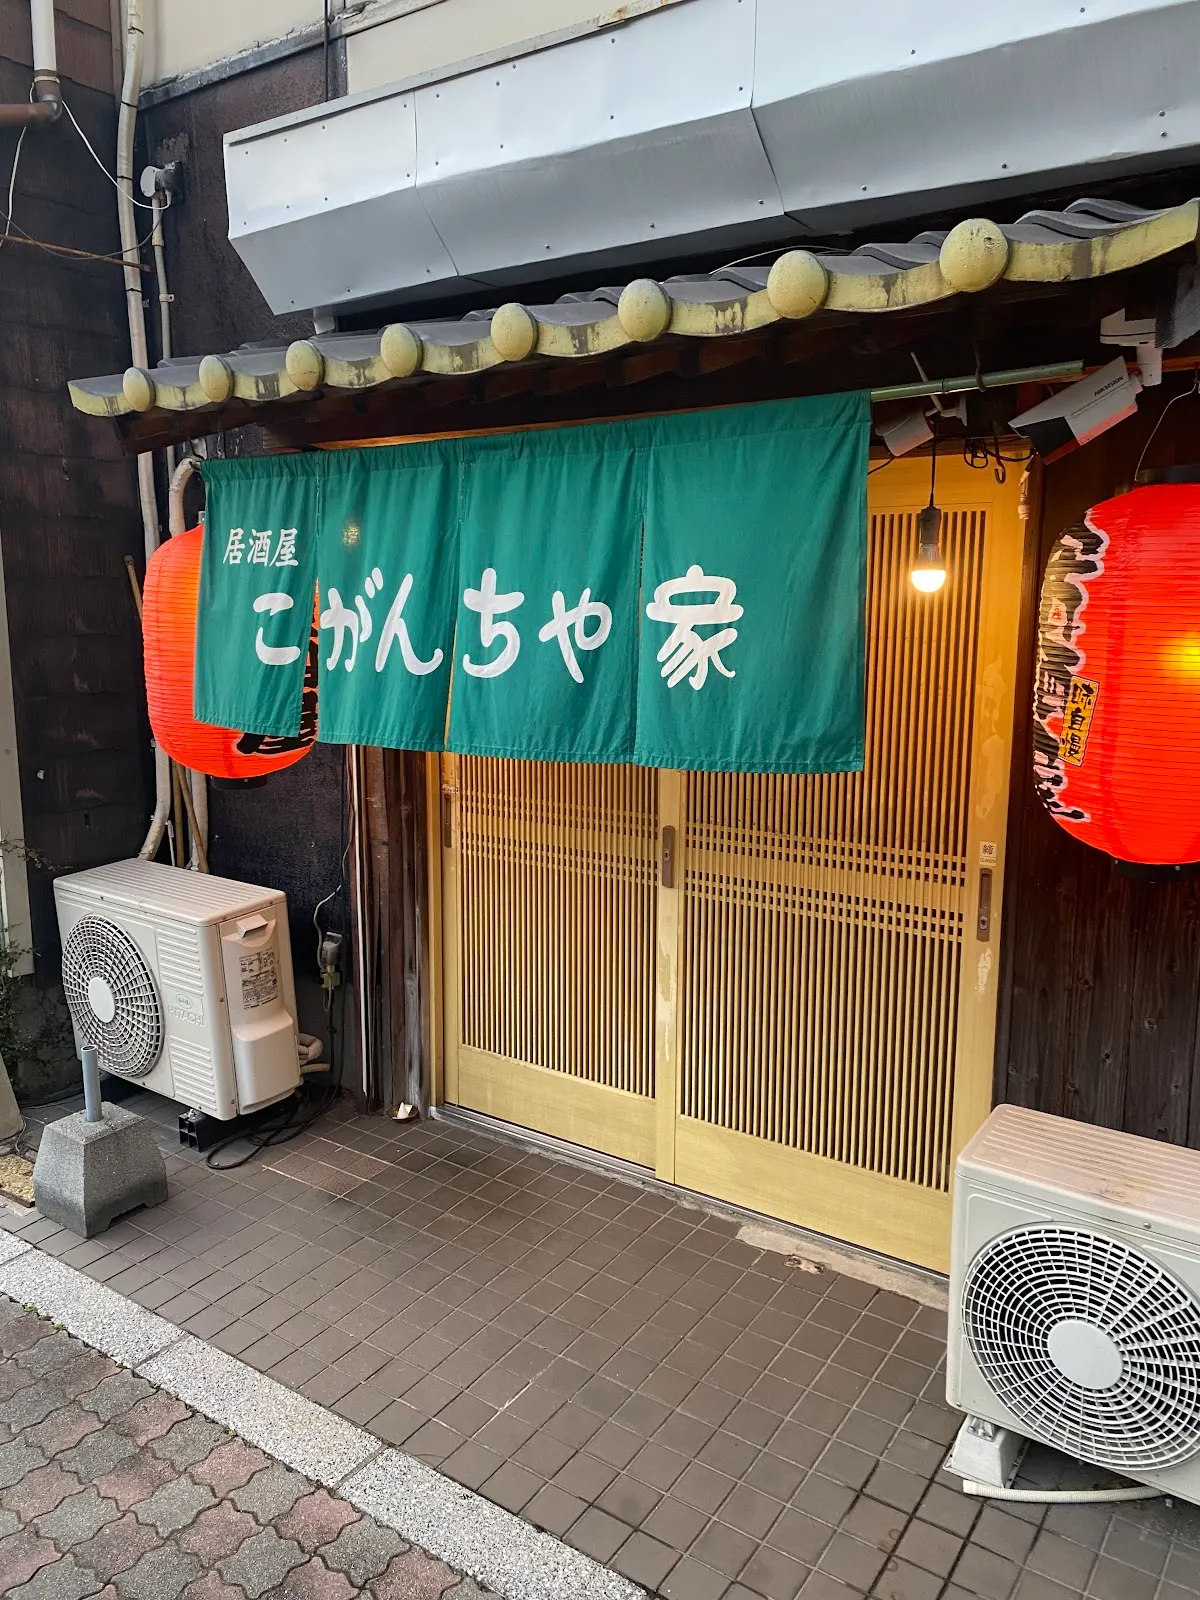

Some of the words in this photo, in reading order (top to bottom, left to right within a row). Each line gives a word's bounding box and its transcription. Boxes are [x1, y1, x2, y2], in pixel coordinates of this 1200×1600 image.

[1094, 375, 1124, 396] HIKVISION
[222, 527, 299, 567] 居酒屋
[167, 1005, 206, 1028] HITACHI
